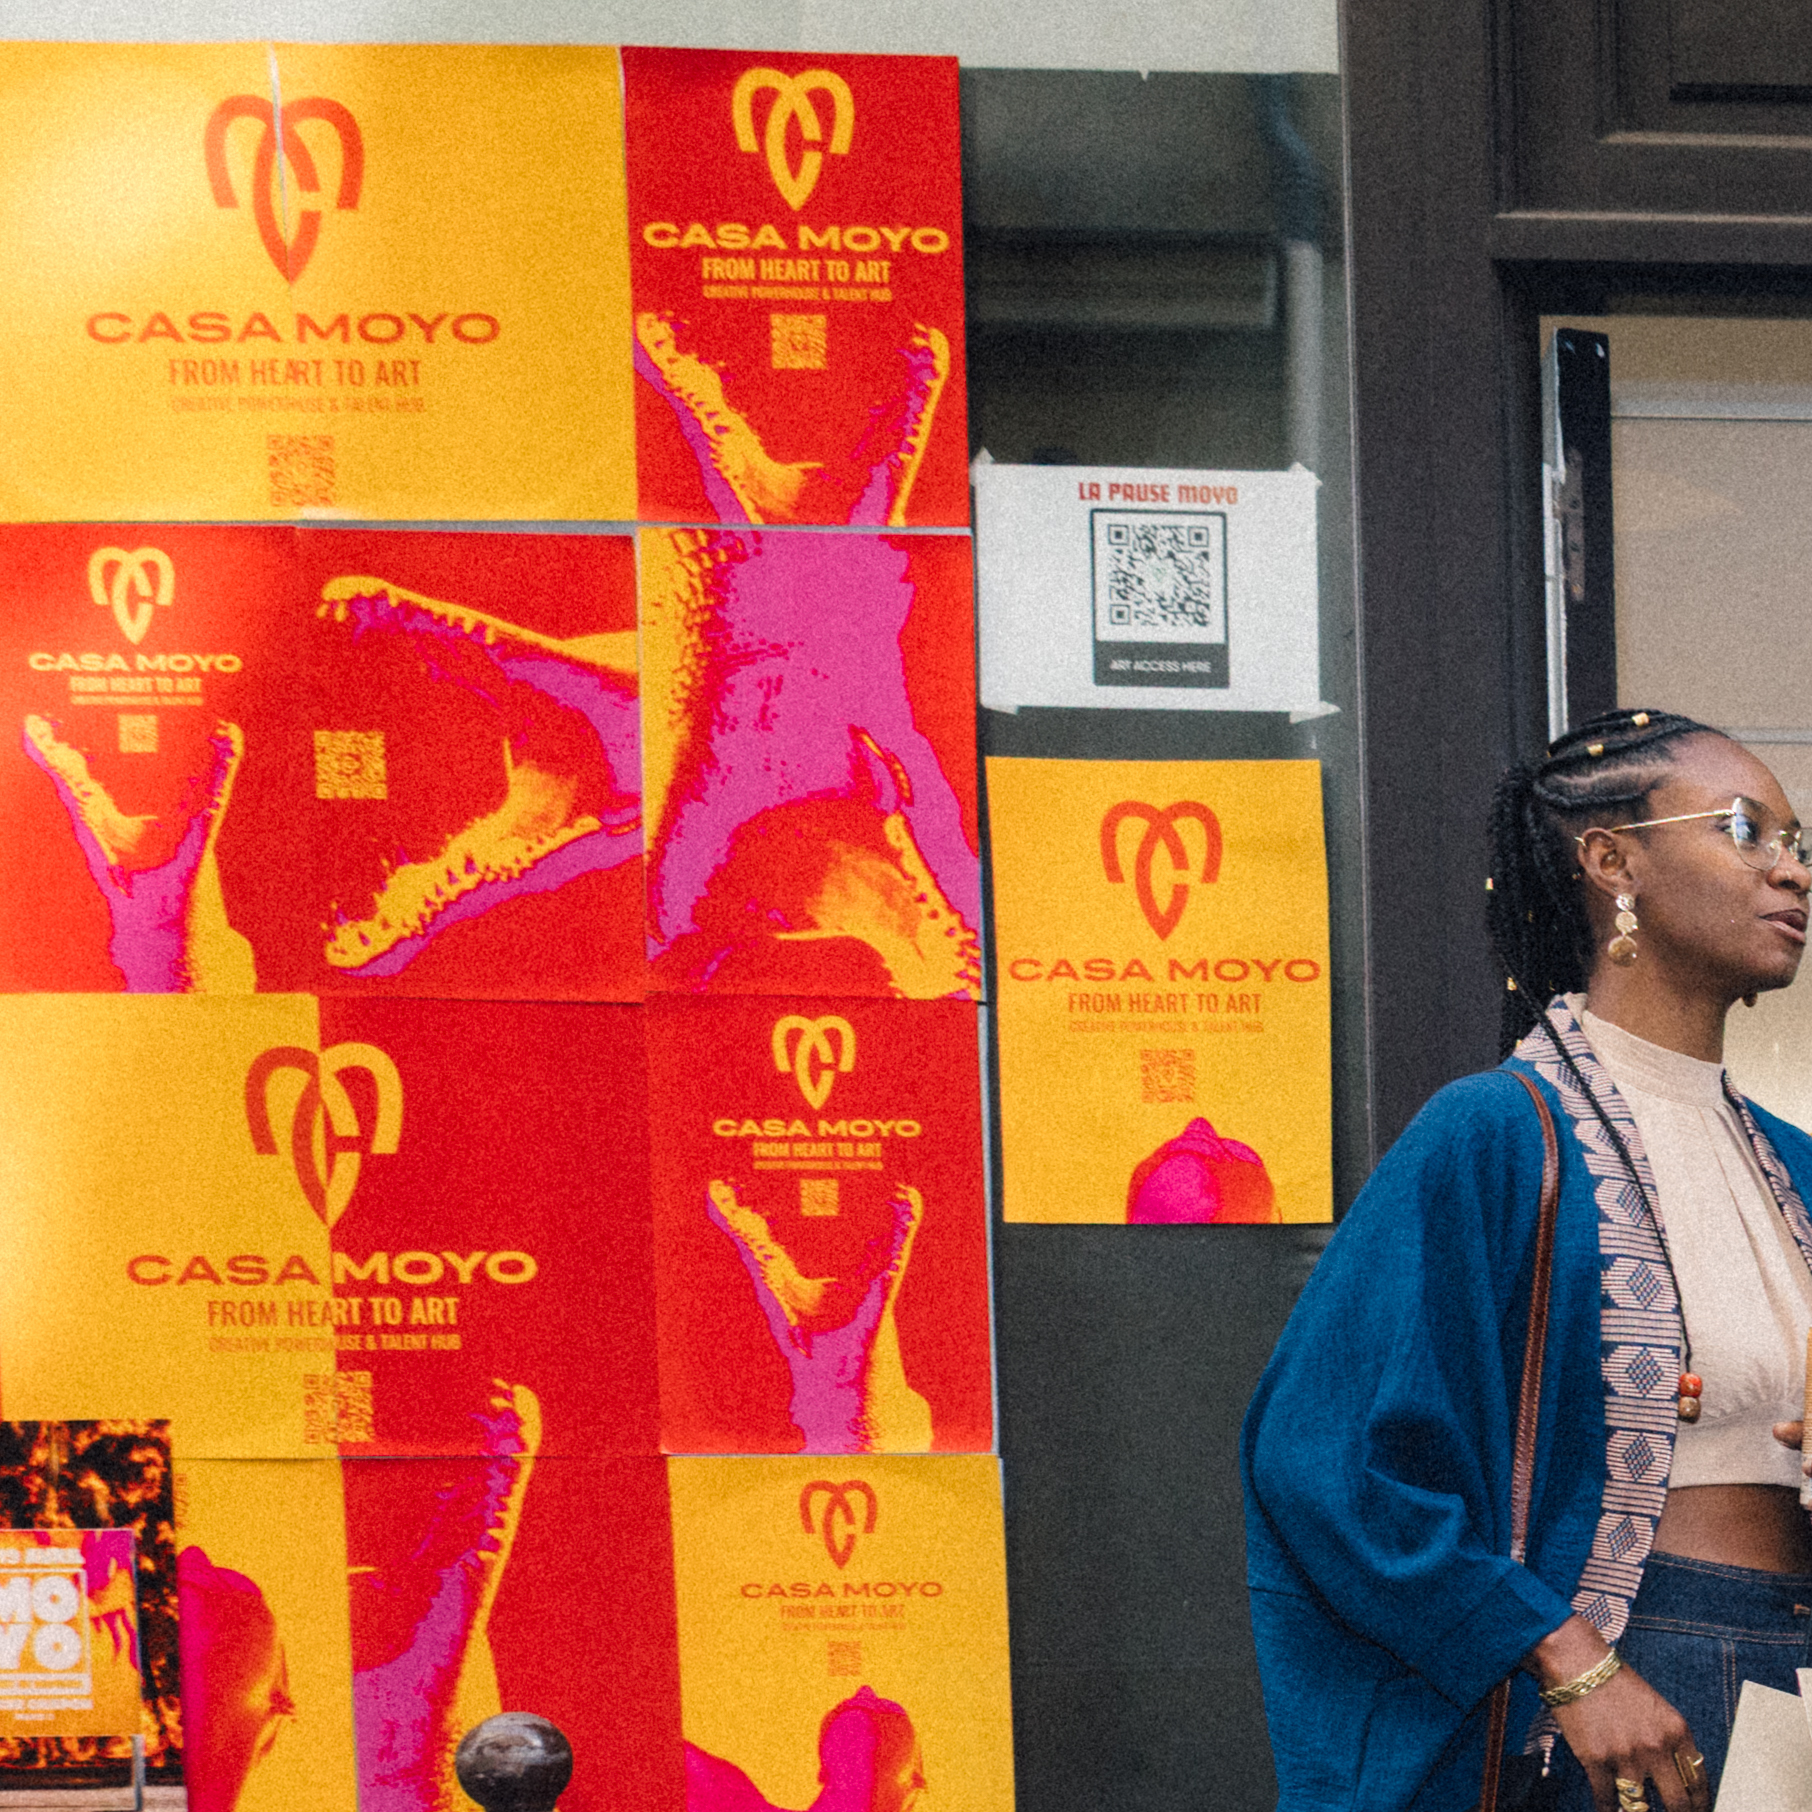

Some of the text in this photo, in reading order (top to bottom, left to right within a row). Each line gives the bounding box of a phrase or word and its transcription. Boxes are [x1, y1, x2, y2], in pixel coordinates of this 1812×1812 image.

[643, 222, 949, 254] CASA MOYO
[702, 257, 891, 284] FROM HEART TO ART
[86, 312, 500, 345] CASA MOYO
[169, 358, 421, 387] FROM HEART TO ART
[1078, 482, 1101, 501] LA
[1109, 483, 1170, 503] PAUSE
[28, 652, 243, 673] CASA MOYO
[1109, 660, 1212, 674] ART ACCESS HERE
[1008, 958, 1321, 983] CASA MOYO
[1068, 993, 1262, 1014] FROM HEART TO ART
[712, 1118, 922, 1137] CASA MOYO
[126, 1250, 538, 1287] CASA MOYO
[207, 1297, 460, 1328] FROM HEART TO ART
[740, 1582, 943, 1599] CASA MOYO
